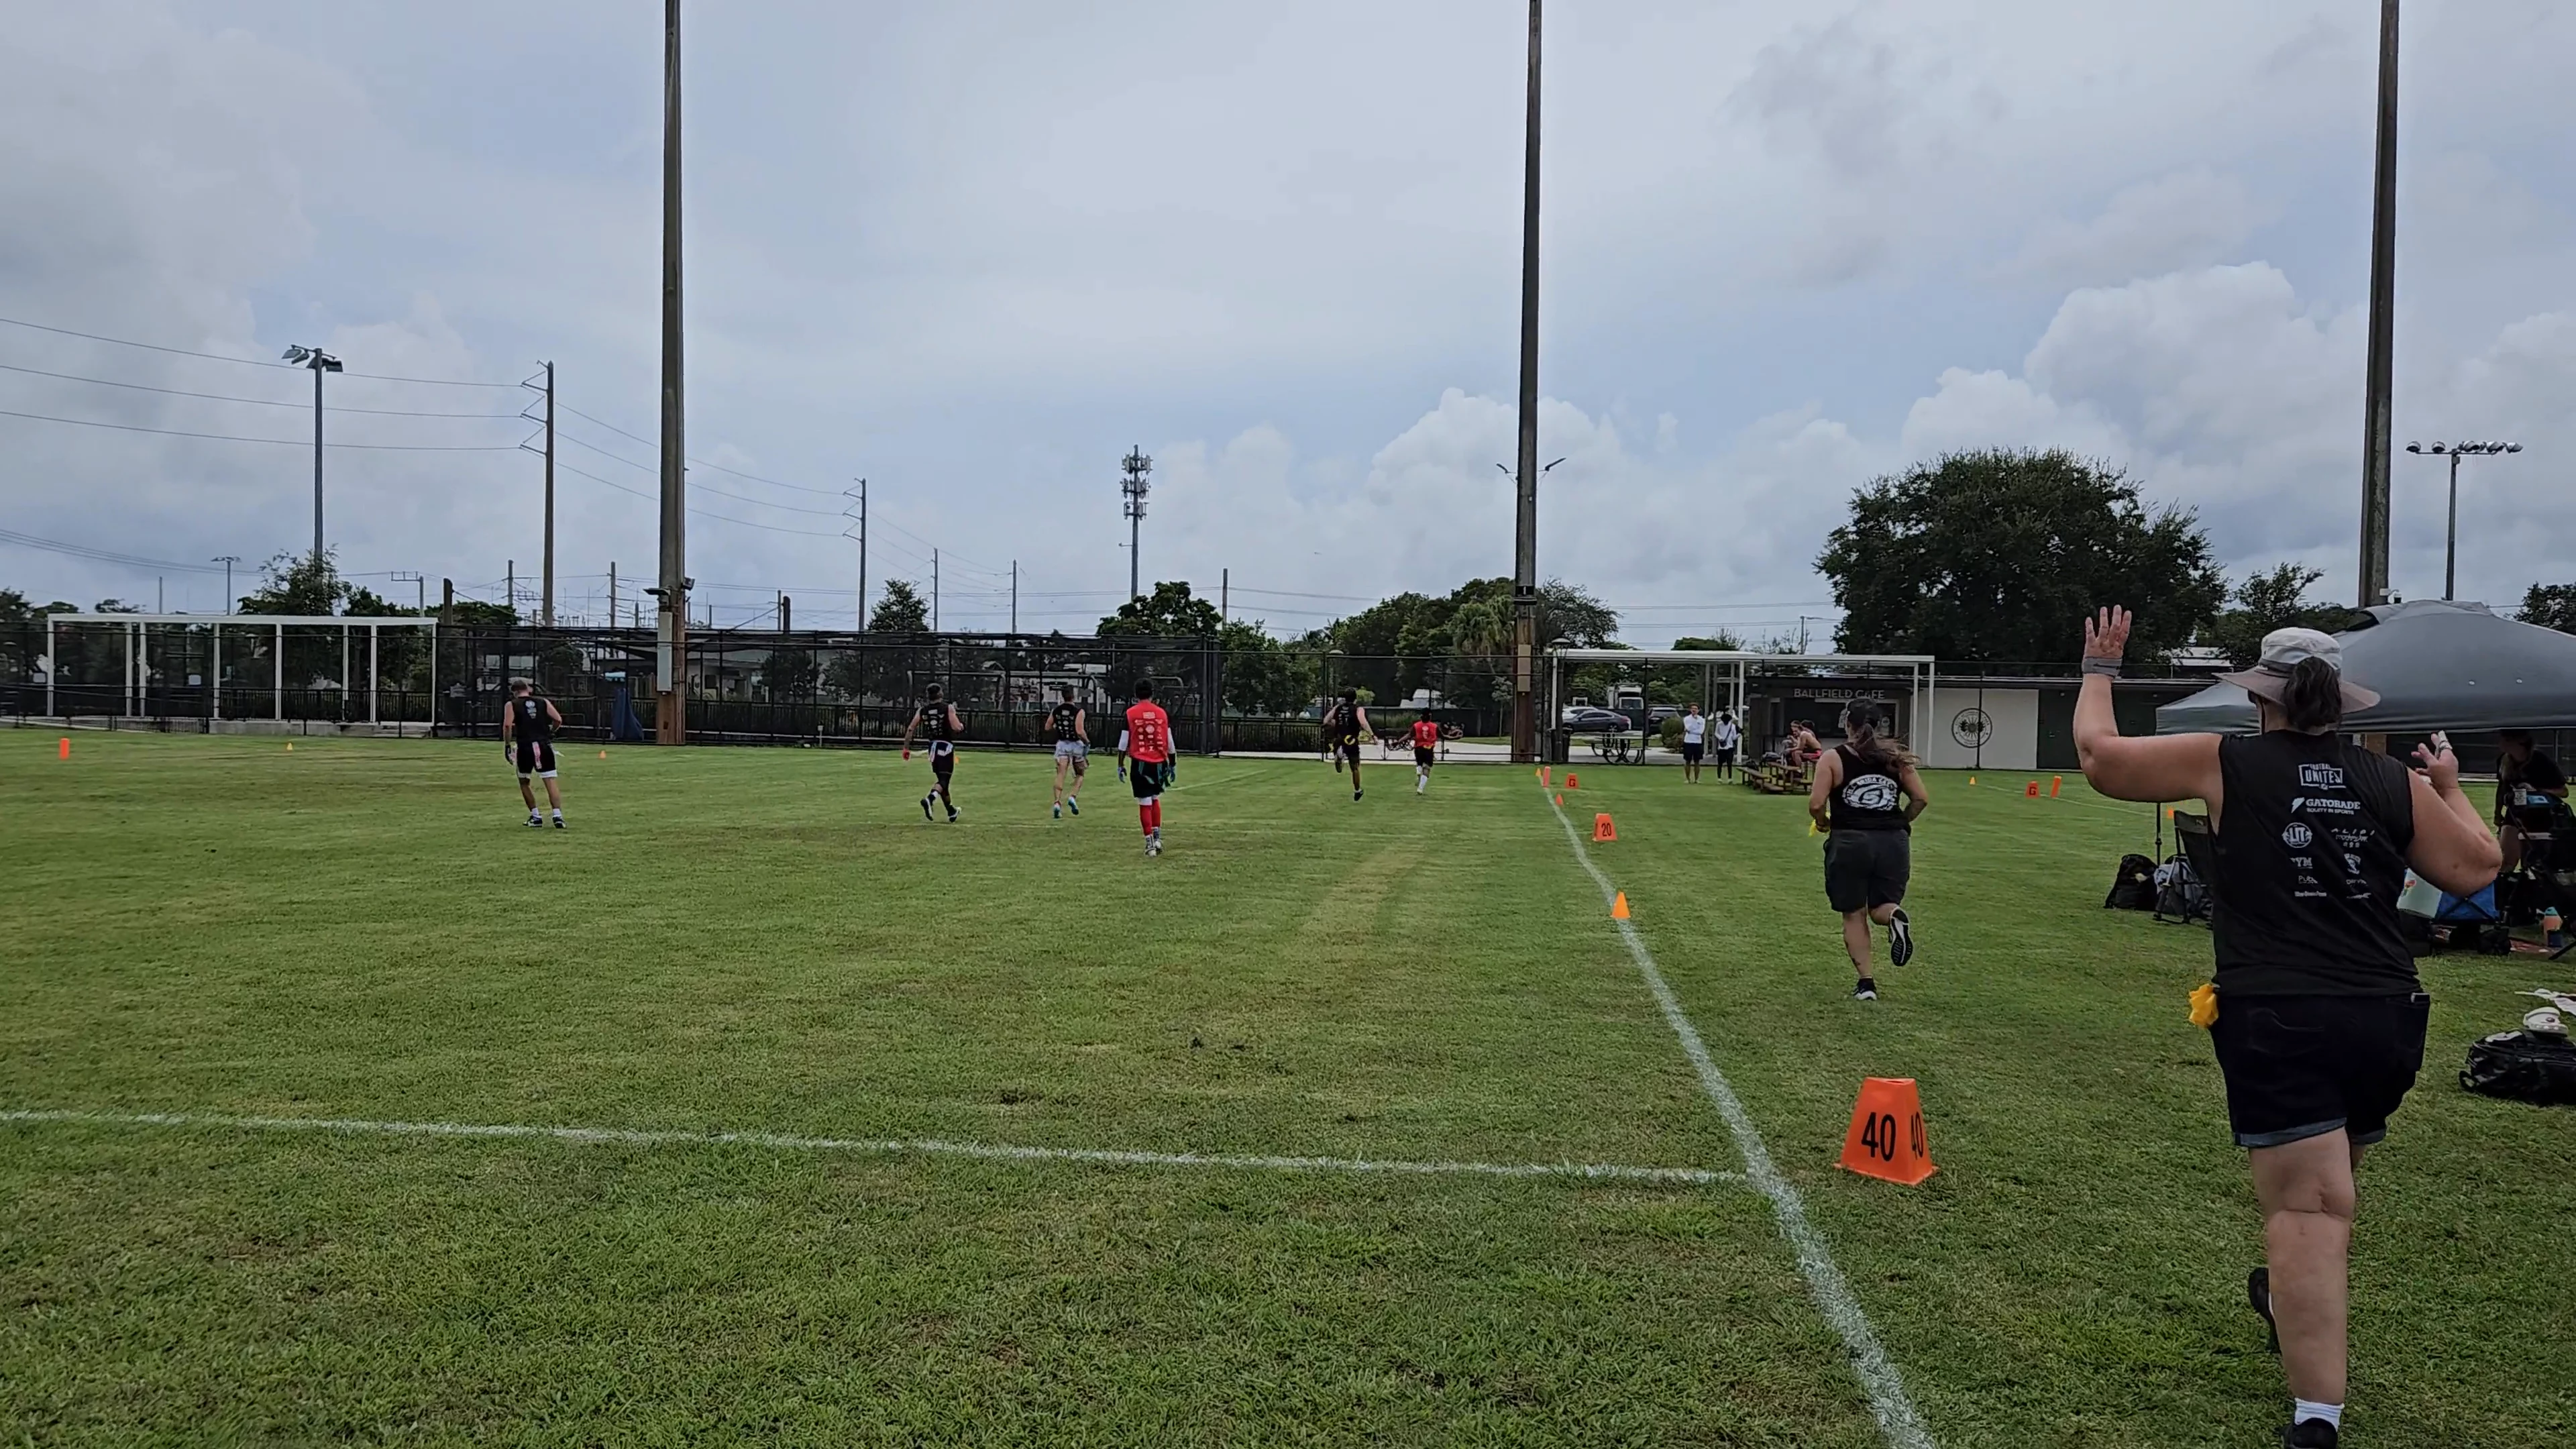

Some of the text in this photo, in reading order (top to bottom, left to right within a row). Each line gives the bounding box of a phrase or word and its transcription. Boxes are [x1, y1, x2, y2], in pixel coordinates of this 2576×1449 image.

[1794, 688, 1853, 698] BALLFIELD
[1569, 778, 1576, 787] G
[2029, 786, 2037, 795] G
[2306, 798, 2361, 810] GATORADE
[1601, 822, 1611, 837] 20
[1861, 1111, 1896, 1162] 40
[1911, 1111, 1924, 1161] 40
